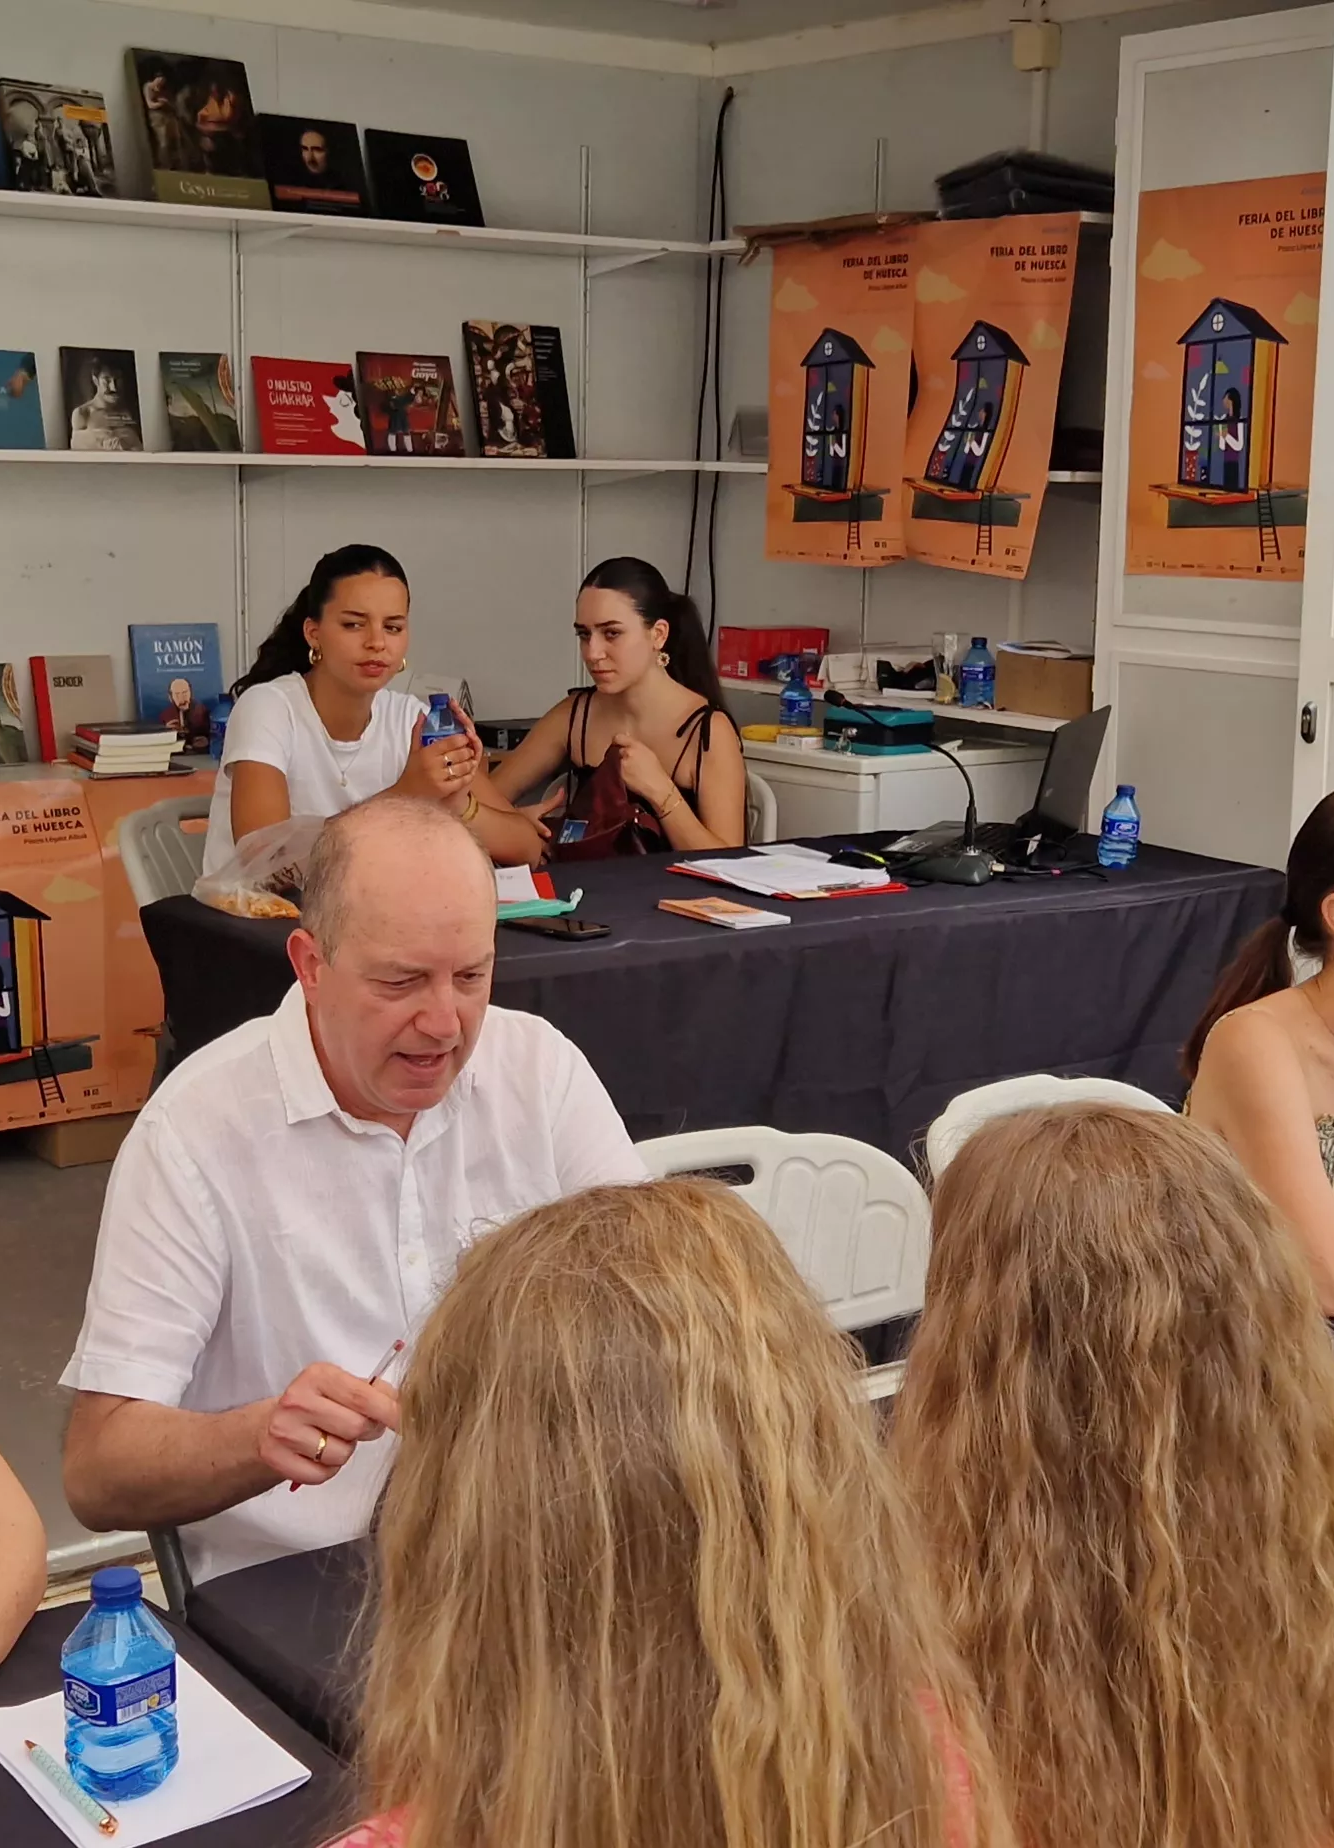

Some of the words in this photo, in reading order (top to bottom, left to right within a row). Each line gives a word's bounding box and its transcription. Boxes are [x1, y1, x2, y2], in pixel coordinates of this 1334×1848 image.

[1239, 212, 1271, 226] FERIA
[1275, 210, 1295, 222] DEL
[1271, 228, 1284, 239] DE
[990, 246, 1014, 257] FERIA
[1019, 245, 1037, 256] DEL
[1041, 244, 1068, 255] LIBRO
[885, 253, 909, 265] LIBRO
[1015, 261, 1026, 271] DE
[1031, 259, 1067, 271] HUESCA
[153, 637, 204, 653] RAMÓN
[164, 652, 205, 665] CAJAL
[53, 676, 84, 688] SENDER
[15, 810, 38, 820] DEL
[43, 807, 81, 819] LIBRO
[12, 824, 28, 834] DE
[33, 820, 84, 832] HUESCA
